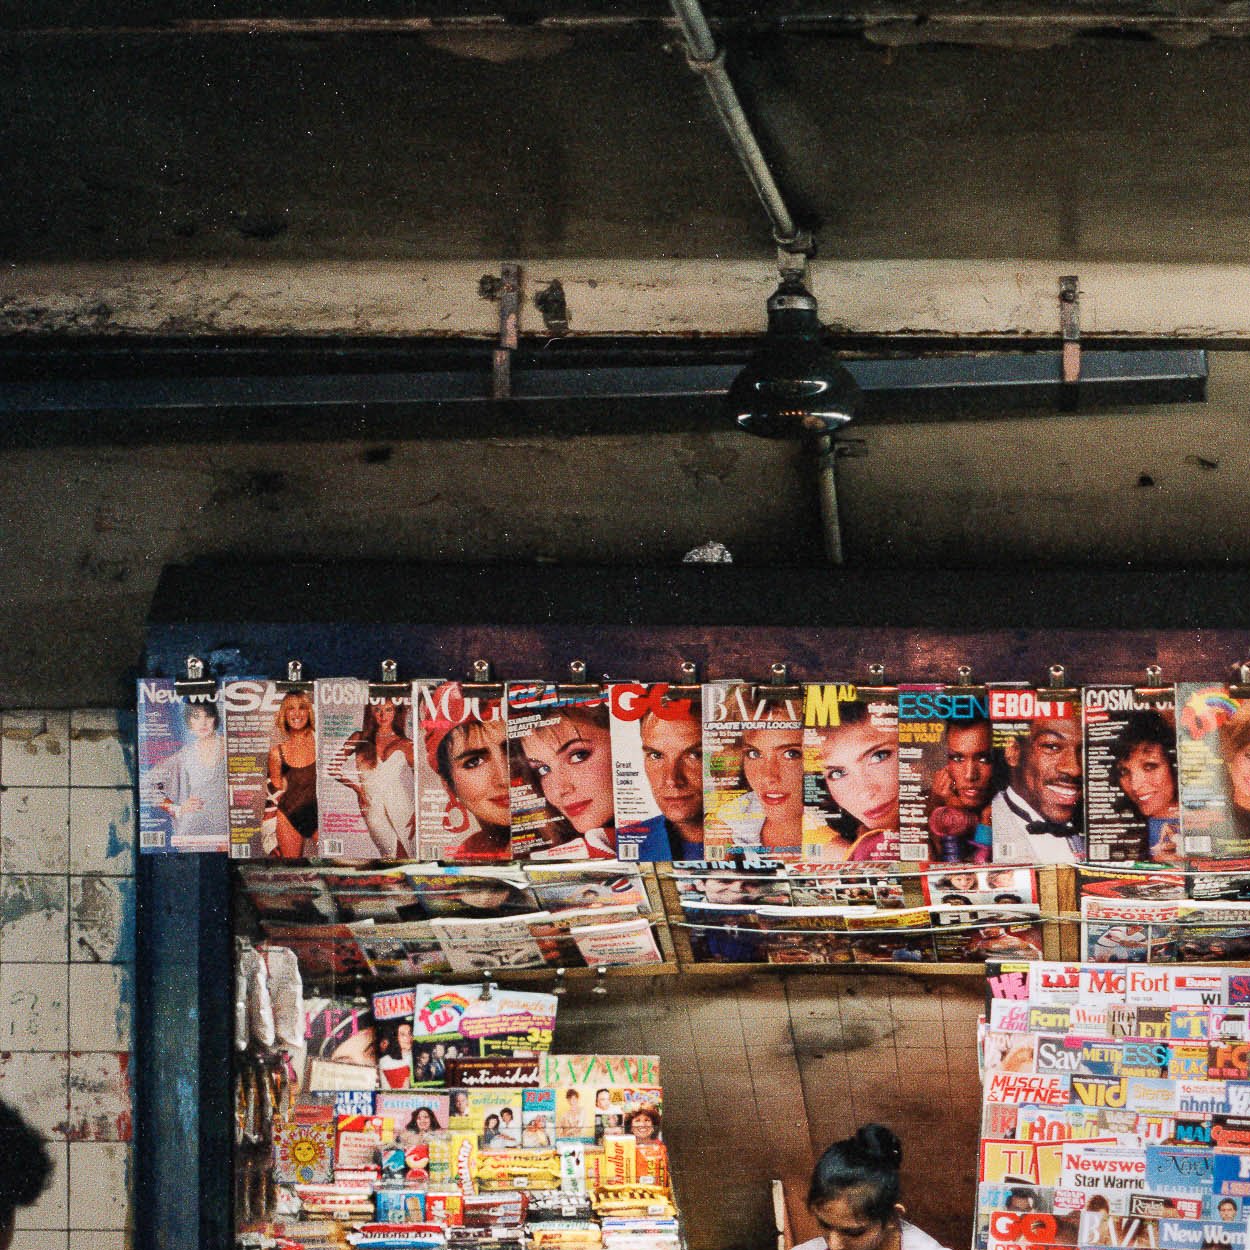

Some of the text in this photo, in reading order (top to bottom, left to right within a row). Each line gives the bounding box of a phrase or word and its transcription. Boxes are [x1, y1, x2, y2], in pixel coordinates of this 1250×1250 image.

[992, 693, 1067, 718] EBONY
[616, 761, 631, 769] Great
[1131, 972, 1169, 993] Fort
[545, 1057, 654, 1083] BAZAAR
[991, 1075, 1059, 1091] MUSCLE
[1075, 1173, 1099, 1187] Star
[1164, 1223, 1202, 1243] New
